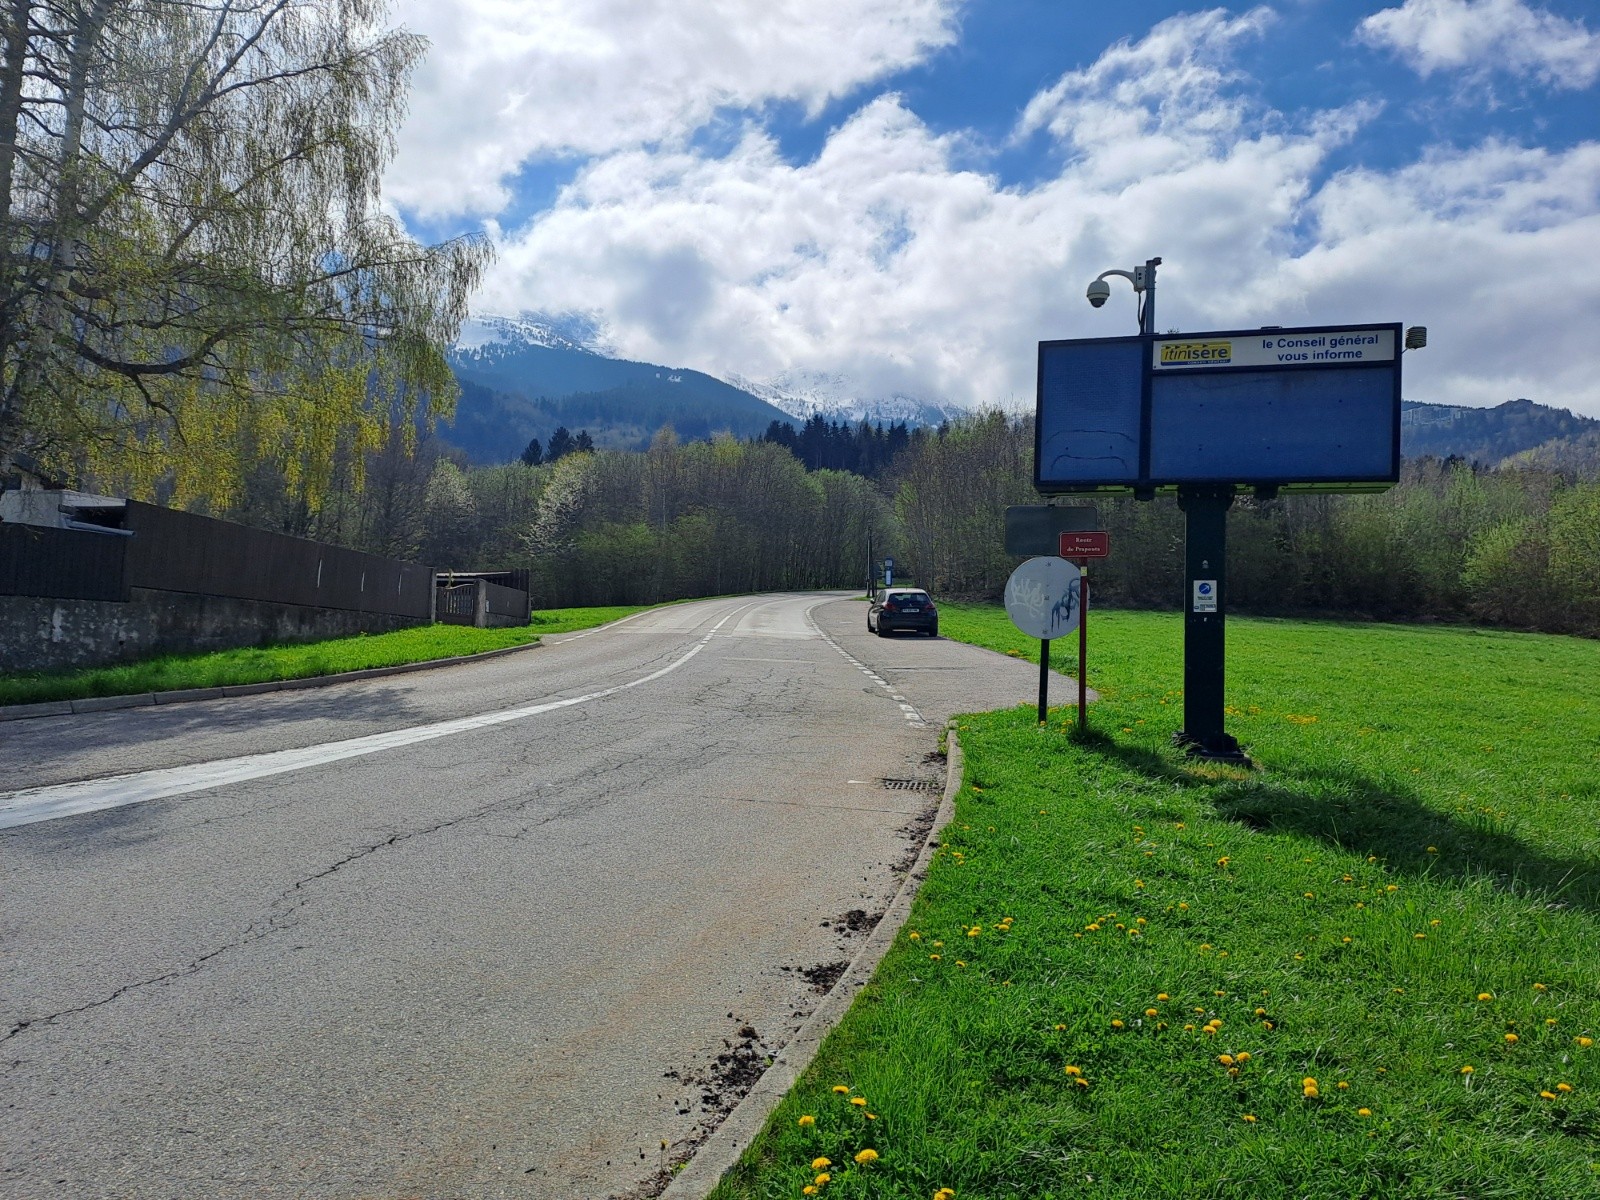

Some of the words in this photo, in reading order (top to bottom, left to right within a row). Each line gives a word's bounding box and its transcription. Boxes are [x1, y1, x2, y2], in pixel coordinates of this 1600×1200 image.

[1262, 340, 1273, 349] le
[1277, 337, 1326, 348] Conseil
[1330, 334, 1379, 349] général
[1277, 352, 1309, 361] vous
[1313, 349, 1363, 360] informe
